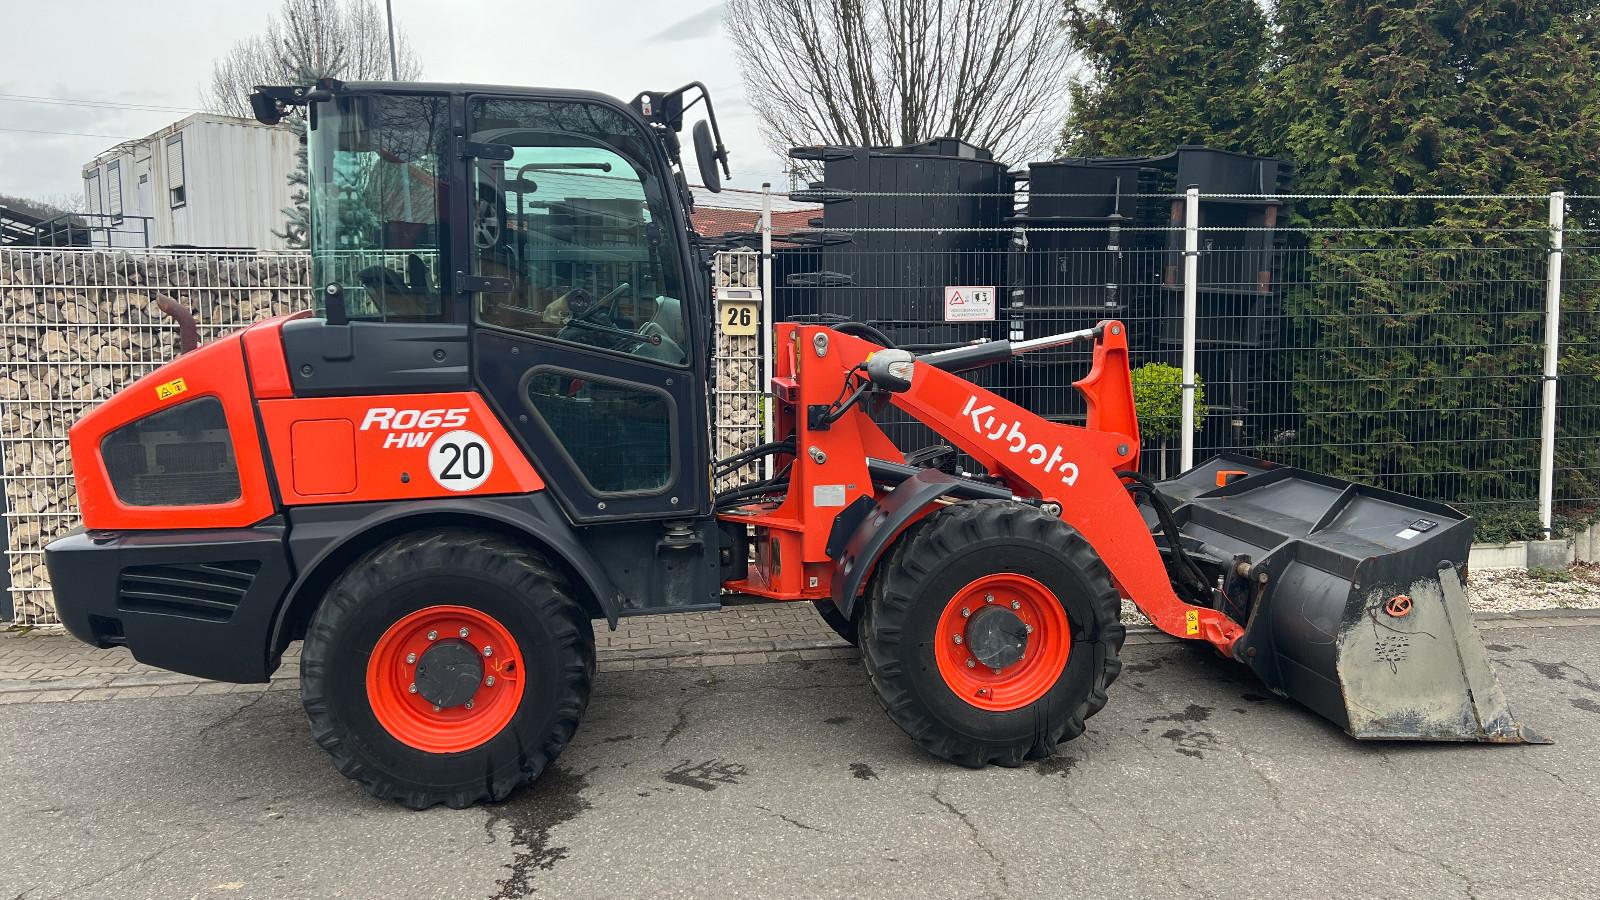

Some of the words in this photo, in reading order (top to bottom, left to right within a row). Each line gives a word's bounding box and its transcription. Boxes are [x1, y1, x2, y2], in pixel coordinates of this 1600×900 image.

[727, 307, 751, 327] 26
[360, 407, 470, 431] R065
[382, 431, 434, 449] HW
[962, 395, 1079, 487] Kubota
[439, 441, 485, 480] 20
